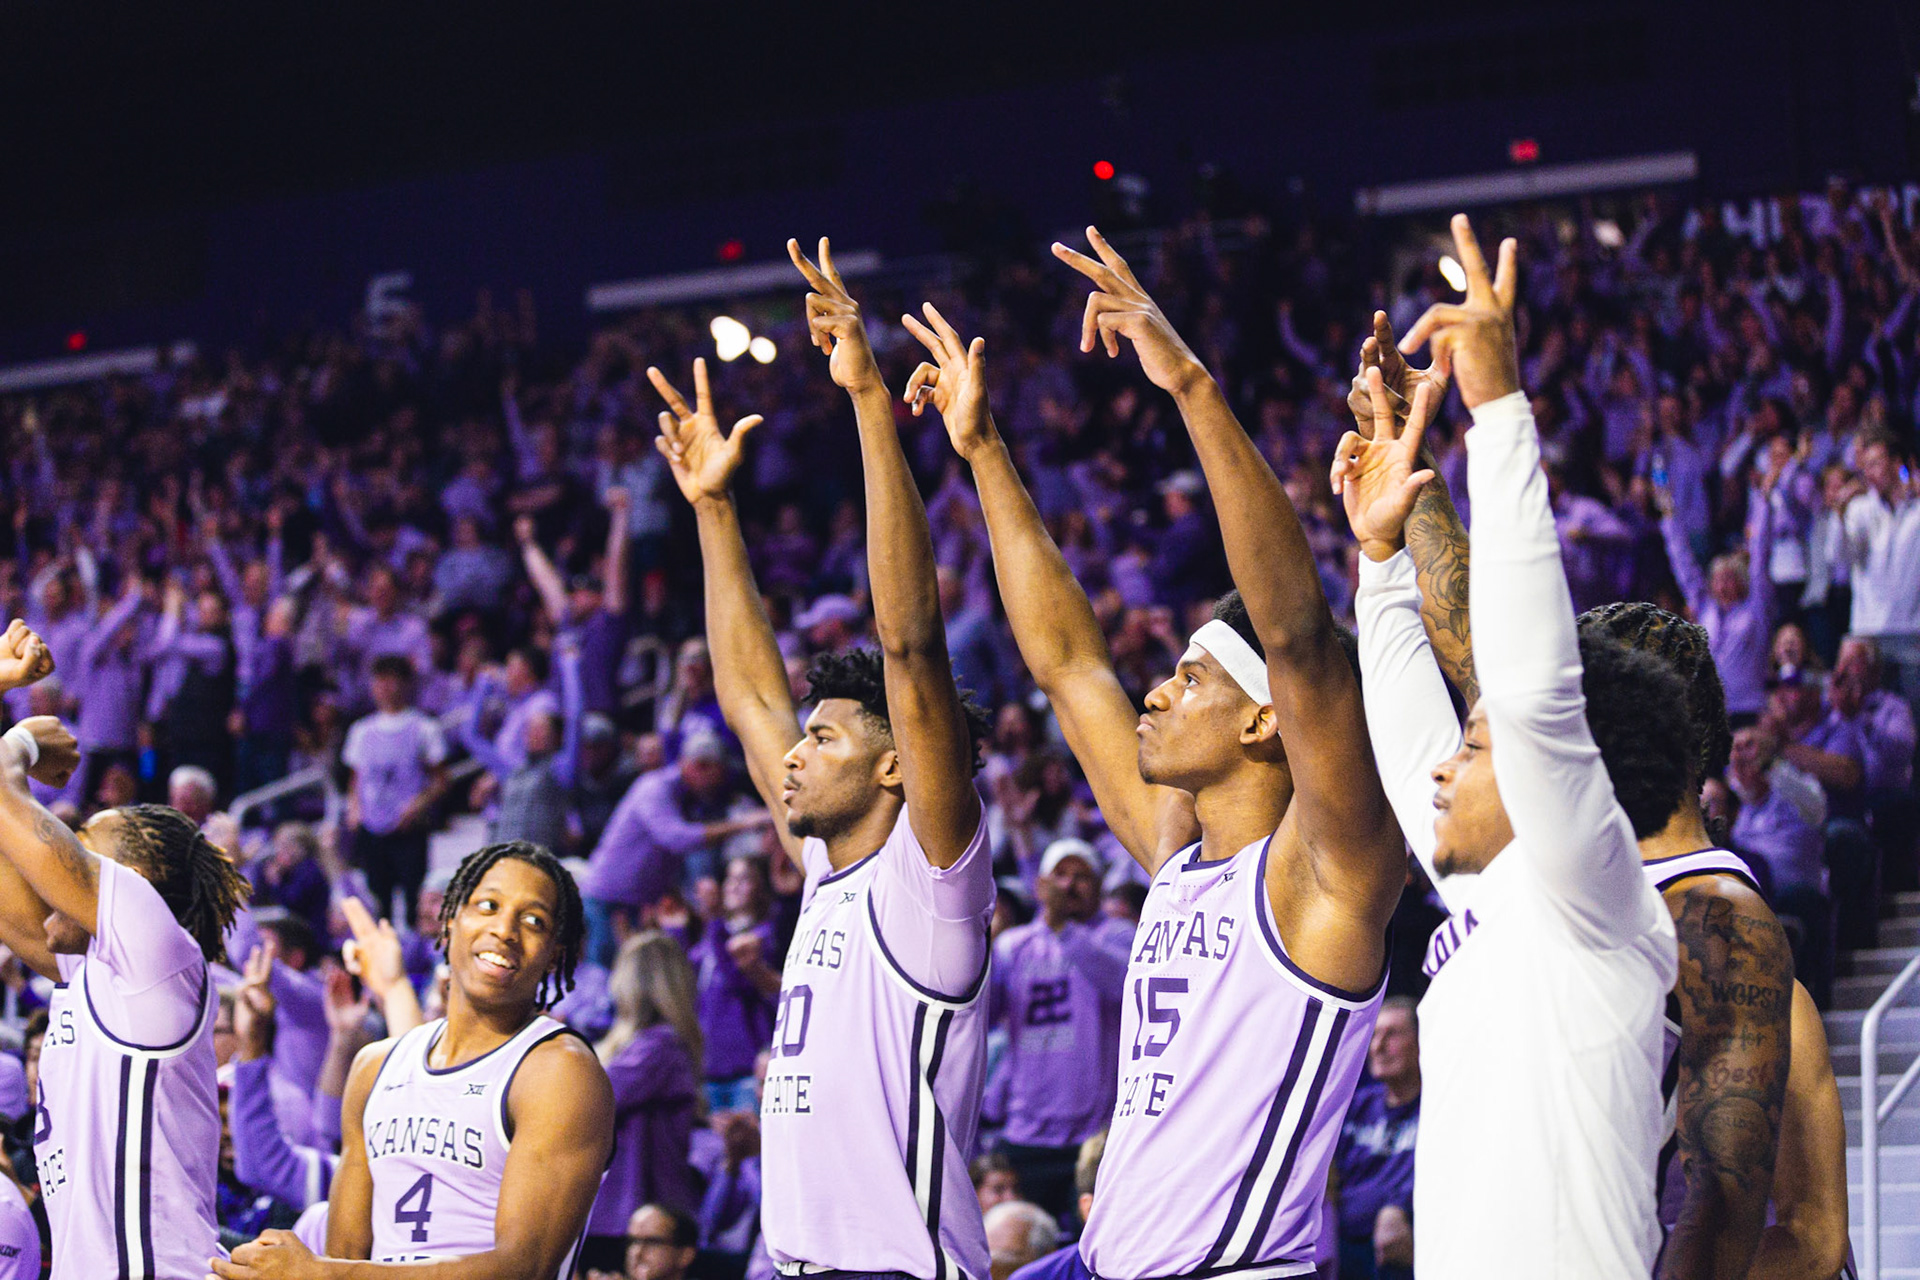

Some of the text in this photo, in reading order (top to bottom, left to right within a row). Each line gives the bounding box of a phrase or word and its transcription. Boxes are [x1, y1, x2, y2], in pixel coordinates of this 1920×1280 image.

[1131, 976, 1189, 1061] 15
[368, 1117, 483, 1169] KANSAS
[395, 1172, 434, 1242] 4
